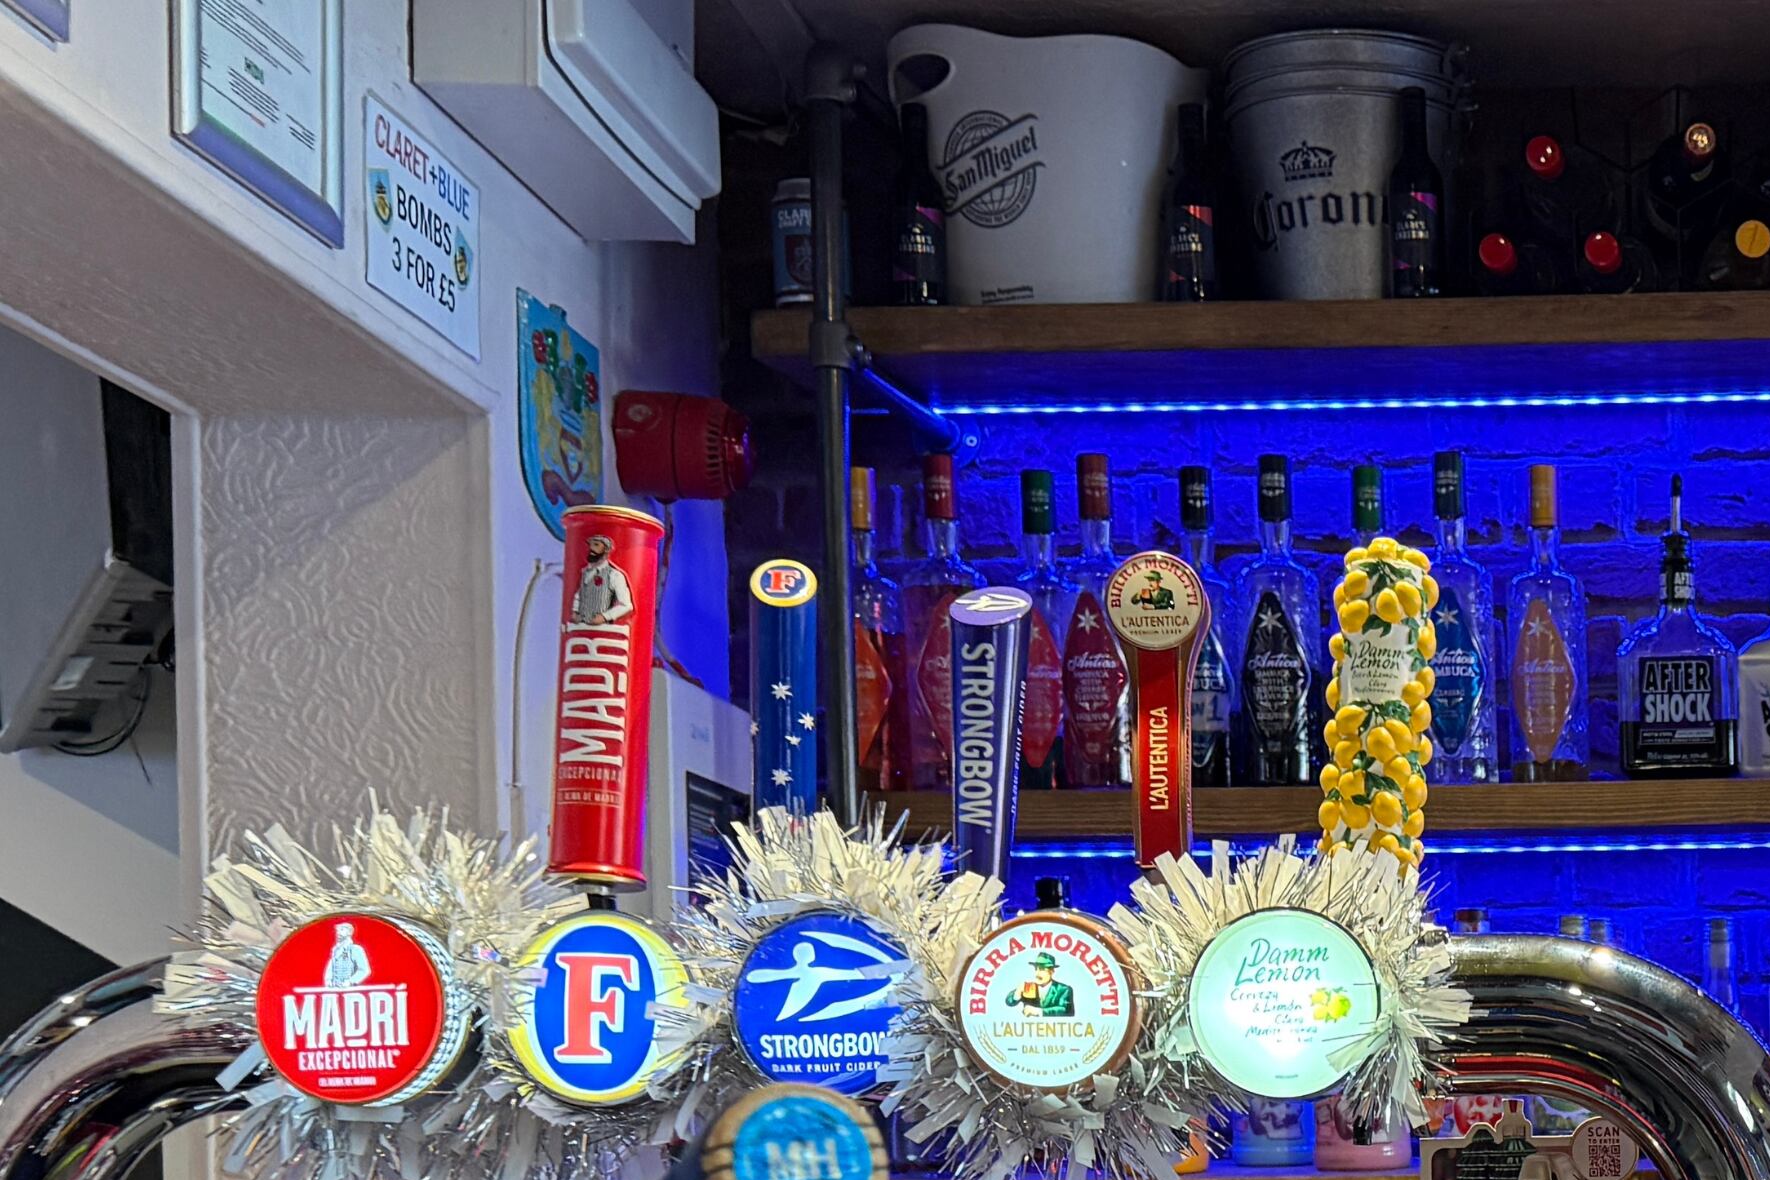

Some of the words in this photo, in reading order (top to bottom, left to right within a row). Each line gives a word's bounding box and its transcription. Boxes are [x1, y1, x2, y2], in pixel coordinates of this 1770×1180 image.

[973, 127, 1038, 178] Miguel
[396, 184, 452, 256] BOMBS
[1252, 191, 1389, 251] Coron
[392, 237, 402, 272] 3
[406, 247, 435, 298] FOR
[438, 272, 456, 313] £5
[767, 569, 800, 594] F
[1111, 563, 1141, 608] BIRRA
[1144, 559, 1198, 606] MORETTI
[1121, 615, 1190, 628] L'AUTENTICA
[1351, 652, 1400, 671] Lemon
[1358, 641, 1405, 659] Damm
[1643, 661, 1711, 693] AFTER
[1645, 693, 1713, 723] SHOCK
[959, 642, 996, 827] STRONGBOW
[1150, 706, 1169, 810] L'AUTENTICA
[1248, 938, 1330, 967] Damm
[970, 937, 1026, 1015] BIRRA
[1031, 931, 1120, 1016] MORETTI
[1234, 956, 1320, 986] Lemon
[554, 953, 640, 1063] F
[993, 1022, 1095, 1038] L'AUTENTICA
[298, 1050, 398, 1071] EXCEPCIONAL
[759, 1031, 890, 1061] STRONGBOW
[1022, 1045, 1040, 1054] DAL
[1043, 1045, 1066, 1054] 1859
[771, 1062, 804, 1073] DARK
[807, 1062, 841, 1073] FRUIT
[1010, 1063, 1048, 1076] PREMIUM
[1053, 1063, 1079, 1075] LAGER
[1588, 1126, 1620, 1137] SCAN
